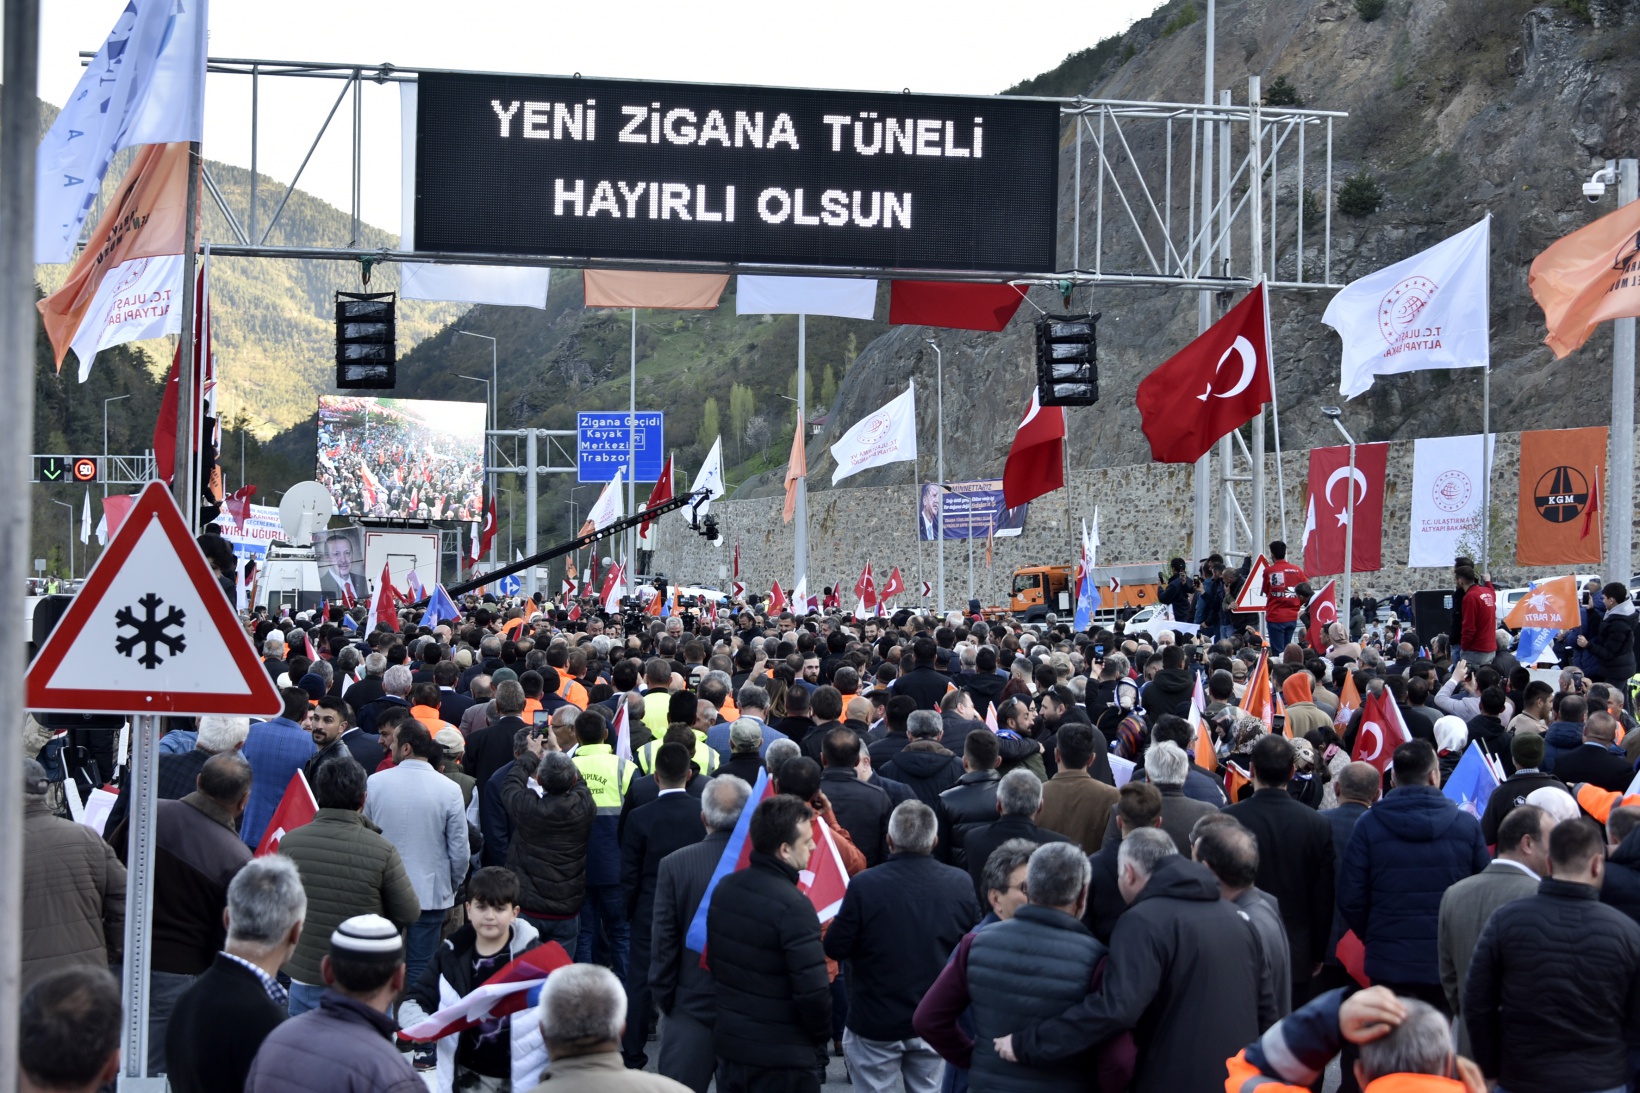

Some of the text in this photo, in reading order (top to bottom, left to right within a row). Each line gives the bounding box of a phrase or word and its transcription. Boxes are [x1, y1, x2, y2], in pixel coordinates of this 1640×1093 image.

[554, 179, 912, 229] HAYIRLI OLSUN
[581, 417, 660, 428] Zigana Geçidi
[587, 429, 622, 440] Kayak
[581, 441, 629, 450] Merkezi
[1548, 495, 1574, 504] KGM
